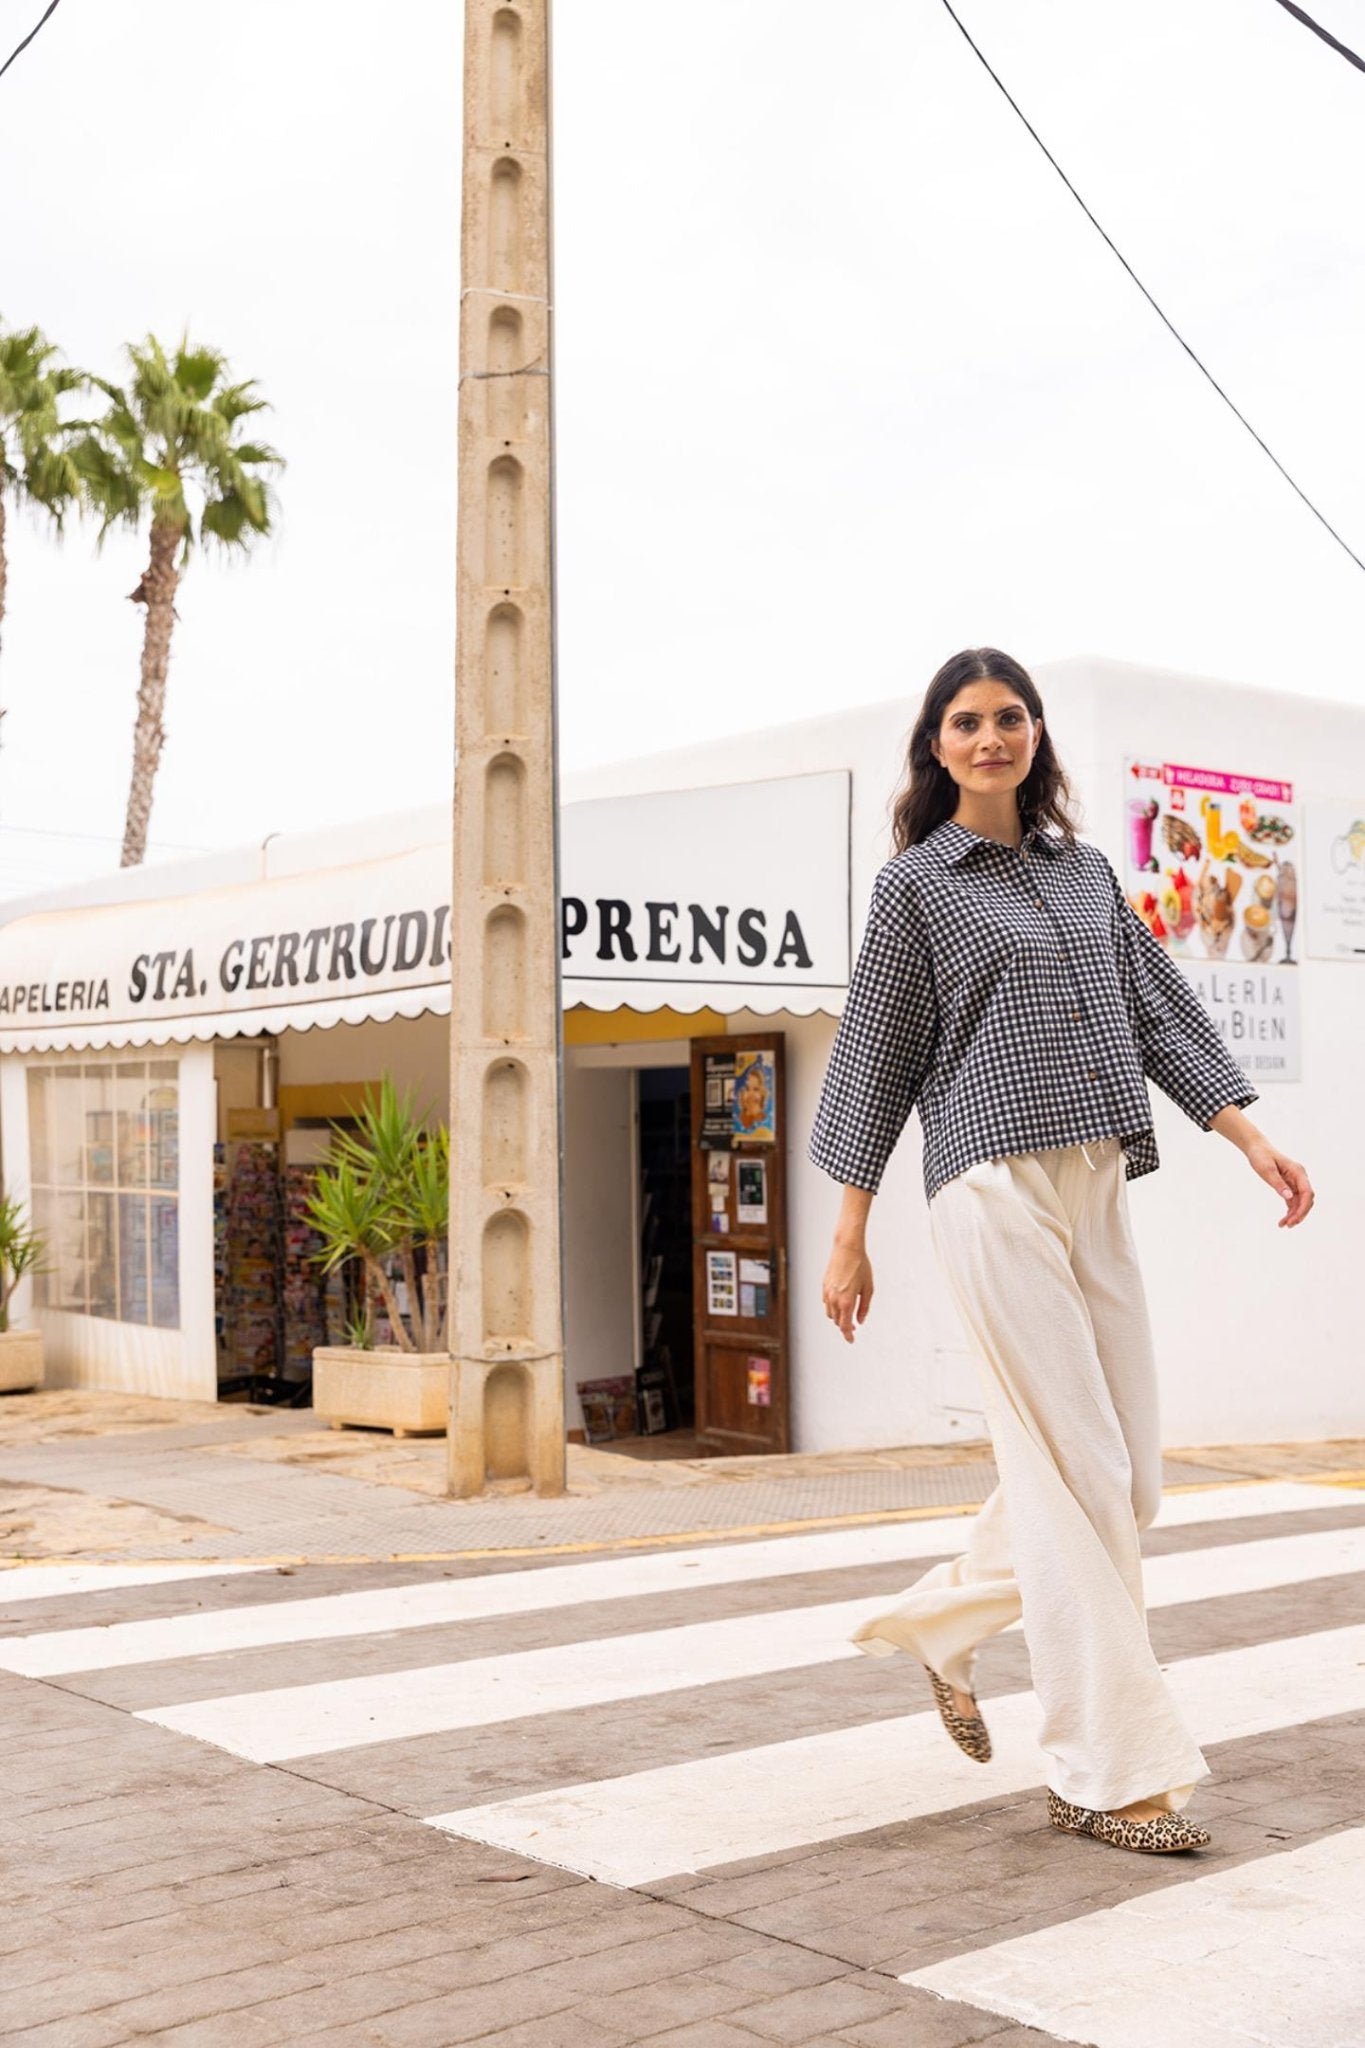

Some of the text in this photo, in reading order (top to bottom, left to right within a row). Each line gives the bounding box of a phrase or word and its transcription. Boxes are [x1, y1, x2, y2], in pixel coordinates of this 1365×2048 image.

[0, 904, 452, 1014] APELERIA STA. GERTRUDI
[562, 897, 814, 969] PRENSA
